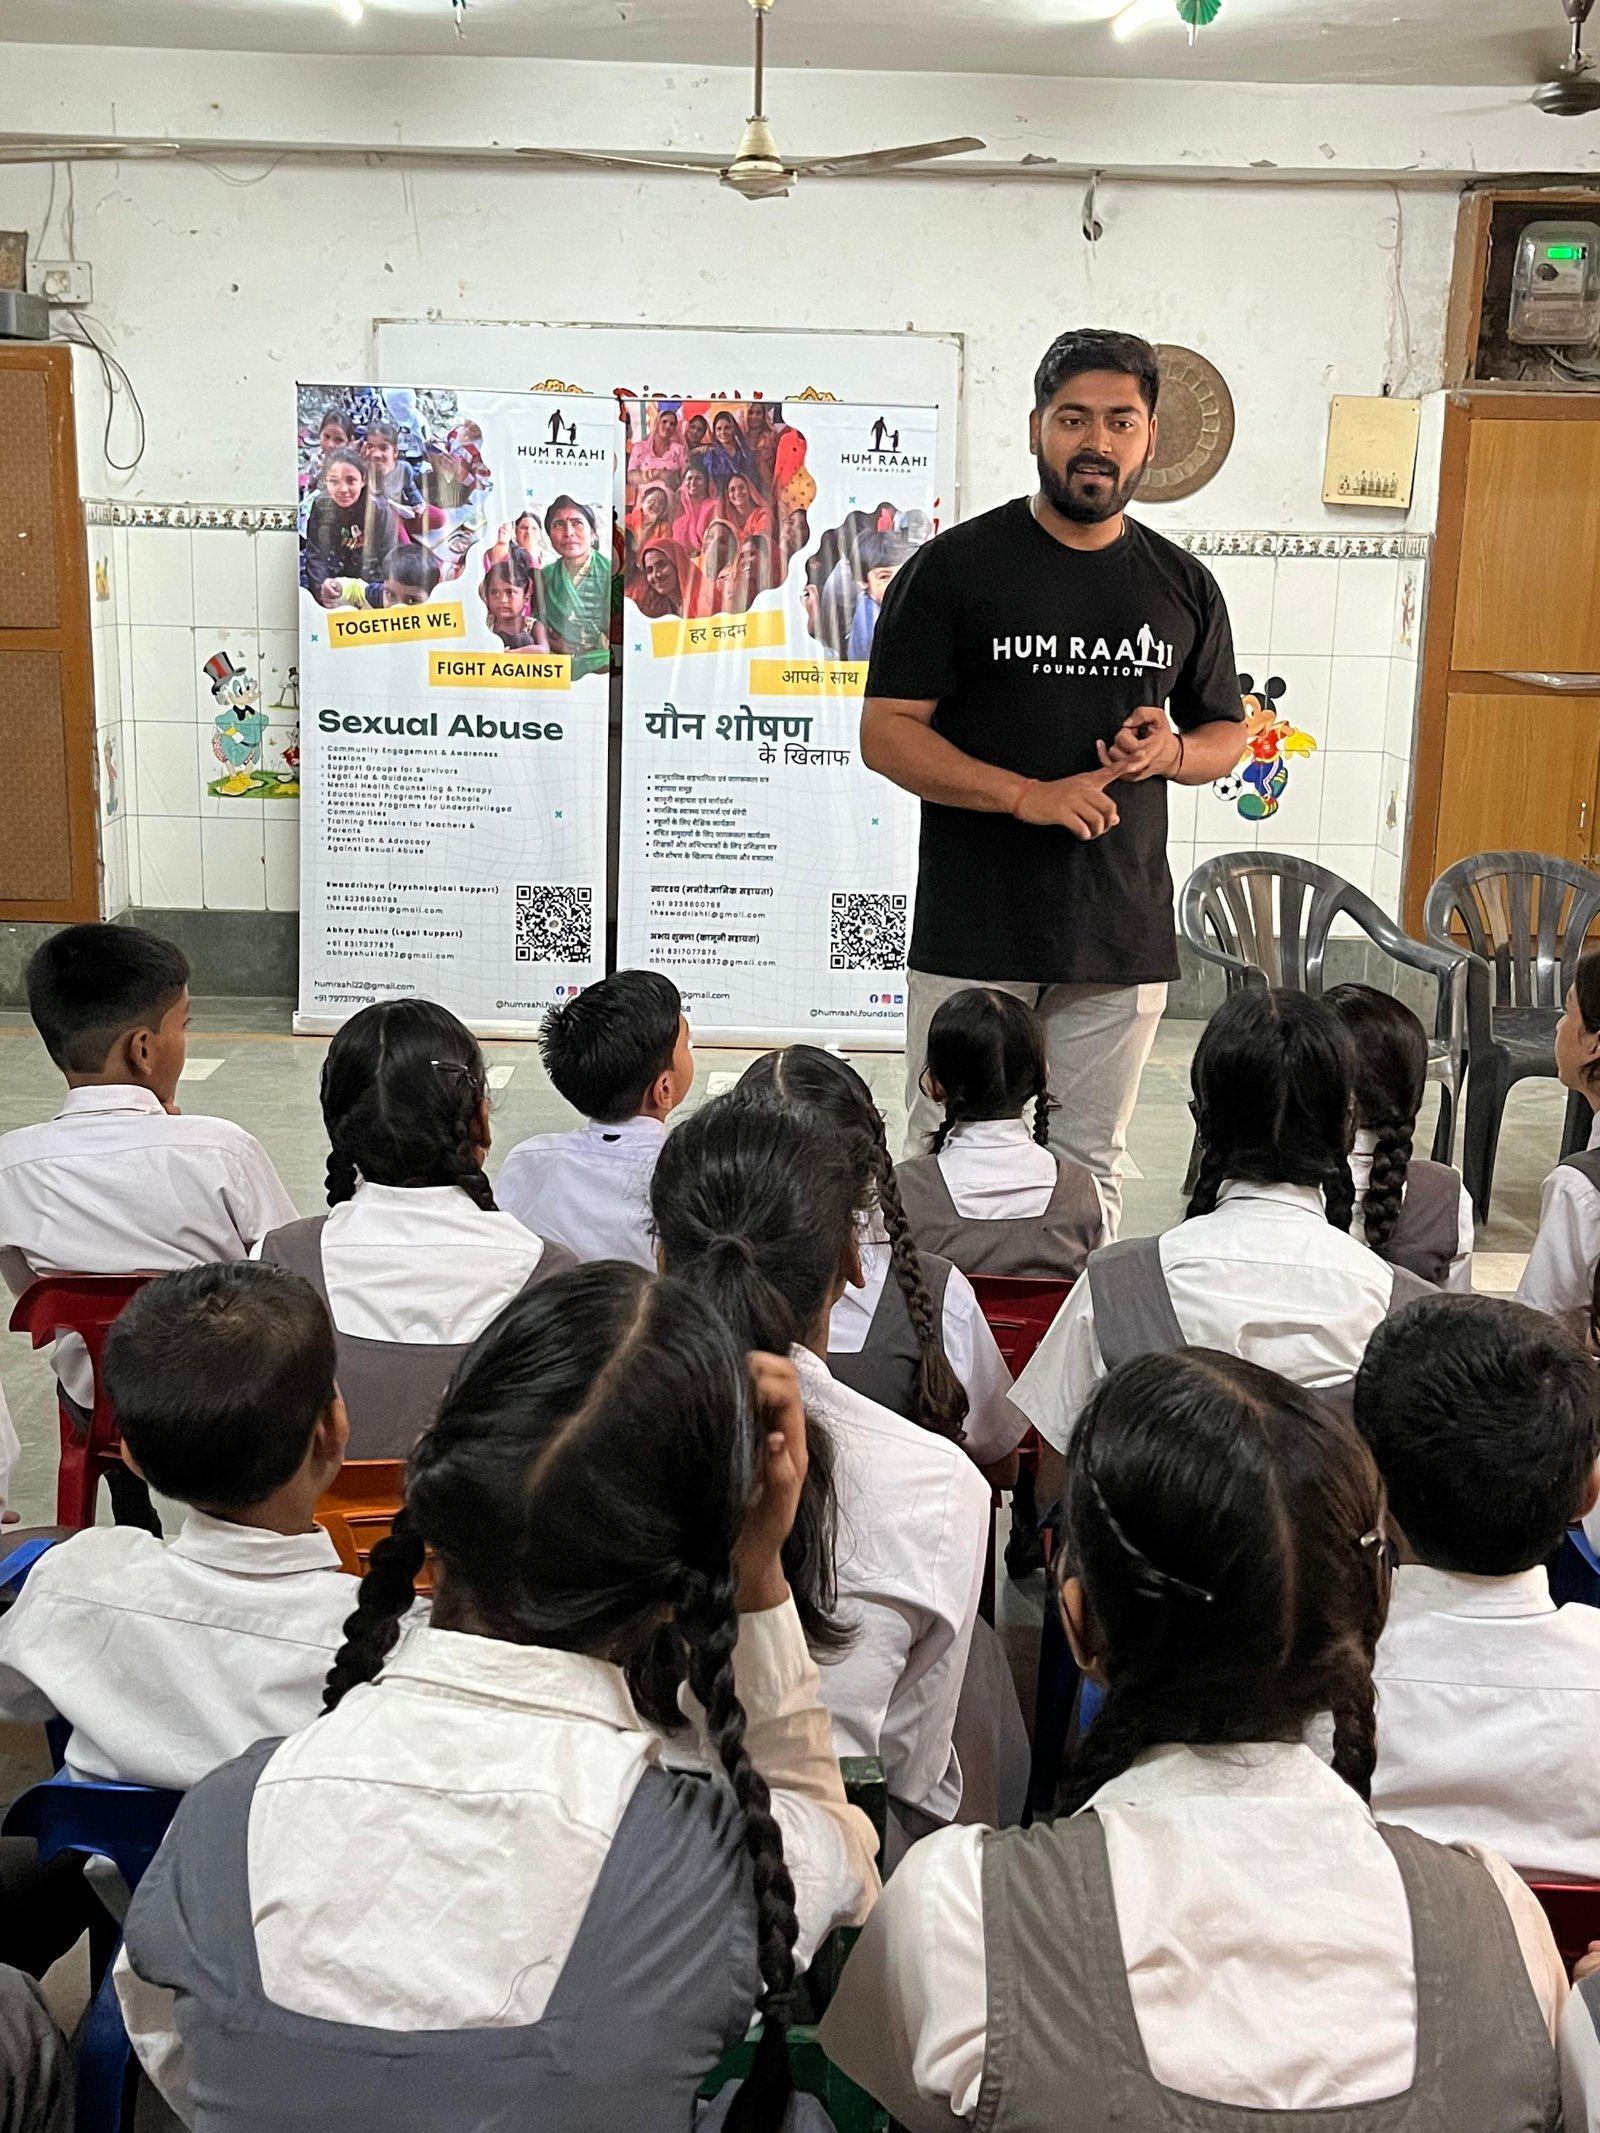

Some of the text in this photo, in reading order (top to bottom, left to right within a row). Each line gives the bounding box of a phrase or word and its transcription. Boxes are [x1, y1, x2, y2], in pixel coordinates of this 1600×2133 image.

[518, 446, 605, 460] HUM RAAHI
[841, 454, 927, 466] HUM RAAHI
[336, 612, 457, 636] TOGETHER WE,
[689, 624, 746, 643] हर कदम
[993, 635, 1057, 660] HUM
[437, 662, 563, 678] FIGHT AGAINST
[782, 666, 858, 685] आपके साथ
[1033, 664, 1143, 677] FOUNDATION
[318, 709, 564, 741] Sexual Abuse
[644, 703, 813, 742] यौन शोषण
[327, 745, 378, 755] Community
[382, 747, 438, 756] Engagement
[450, 750, 498, 758] Awareness
[758, 742, 850, 766] के खिलाफ
[327, 754, 366, 762] Sessions
[366, 765, 397, 773] Groups
[327, 773, 351, 781] Legal
[381, 774, 423, 782] Guidance
[394, 784, 443, 793] Counseling
[456, 786, 492, 795] Therapy
[327, 791, 381, 799] Educational
[384, 793, 426, 801] Programs
[379, 801, 420, 810] Programs
[327, 808, 386, 817] Communities
[327, 818, 364, 827] Training
[388, 838, 431, 847] Advocacy
[327, 845, 361, 853] Against
[389, 882, 456, 892] (Psychological
[460, 885, 499, 894] Support)
[326, 927, 354, 935] Abhay
[392, 927, 420, 937] (Legal
[423, 930, 463, 938] Support)
[314, 980, 415, 990] humraahi22@gmail.com
[810, 1008, 904, 1018] @humraahi.foundation
